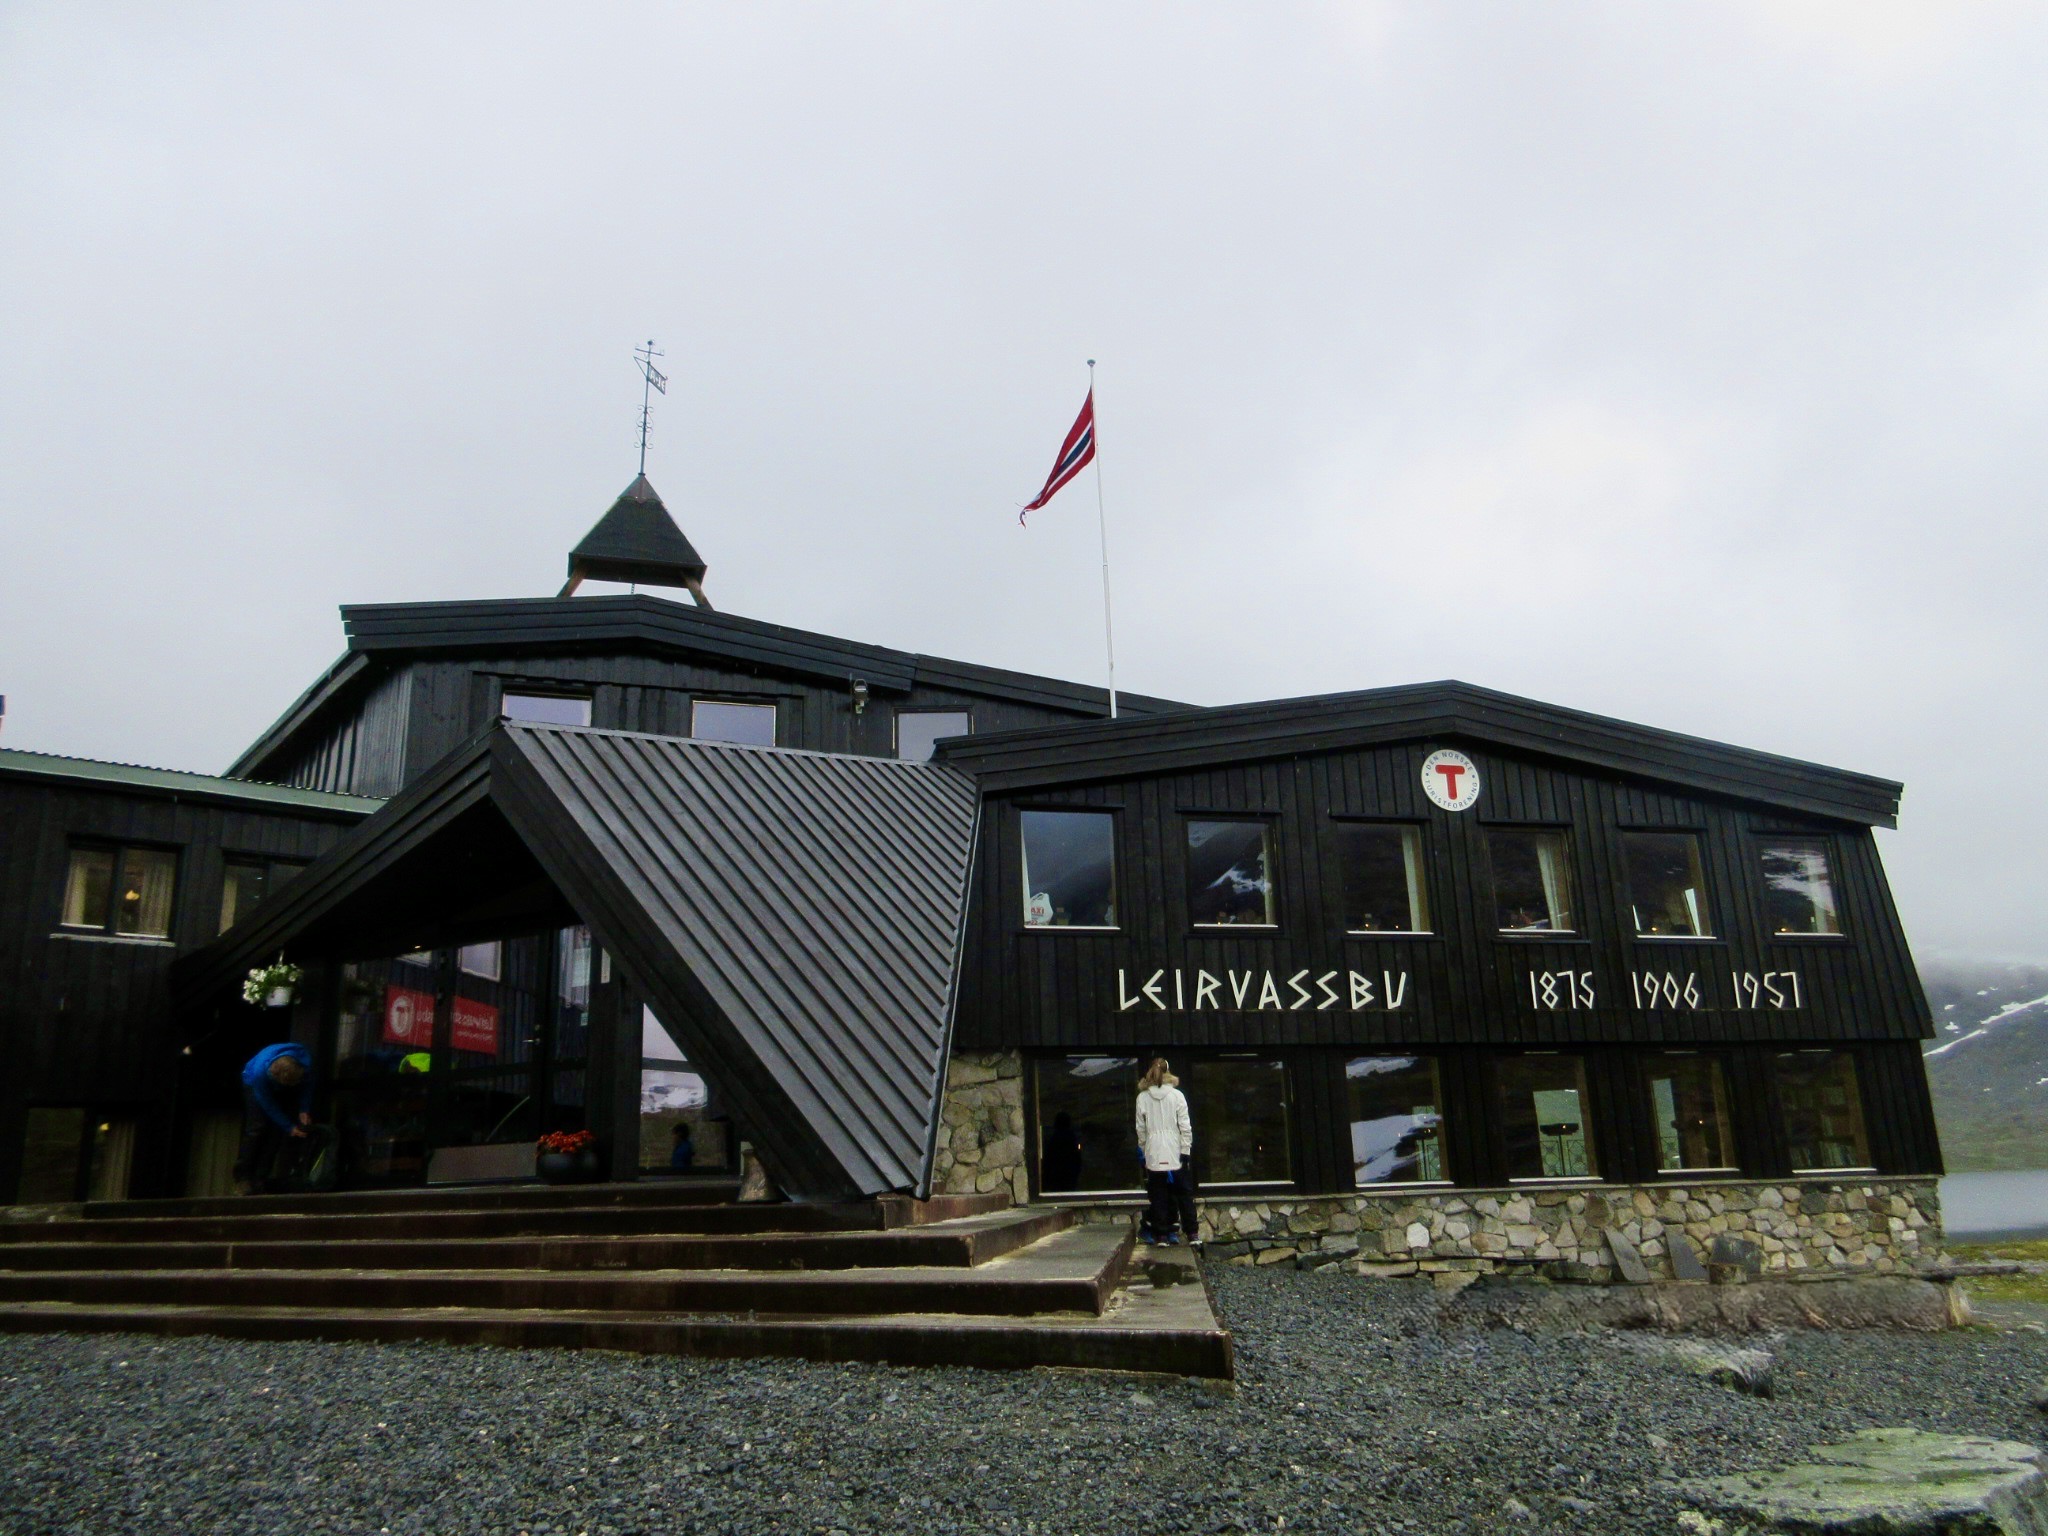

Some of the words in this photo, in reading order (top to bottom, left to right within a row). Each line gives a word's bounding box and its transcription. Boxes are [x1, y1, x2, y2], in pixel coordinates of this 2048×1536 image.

[1426, 755, 1439, 770] DEN
[1441, 751, 1474, 771] NORSKE
[1425, 779, 1478, 809] TURISTFORENING
[1435, 764, 1466, 800] T
[1118, 968, 1407, 1011] LEIRVASSBU
[1530, 970, 1595, 1009] 1875
[1632, 971, 1699, 1009] 1906
[1733, 971, 1800, 1009] 1957
